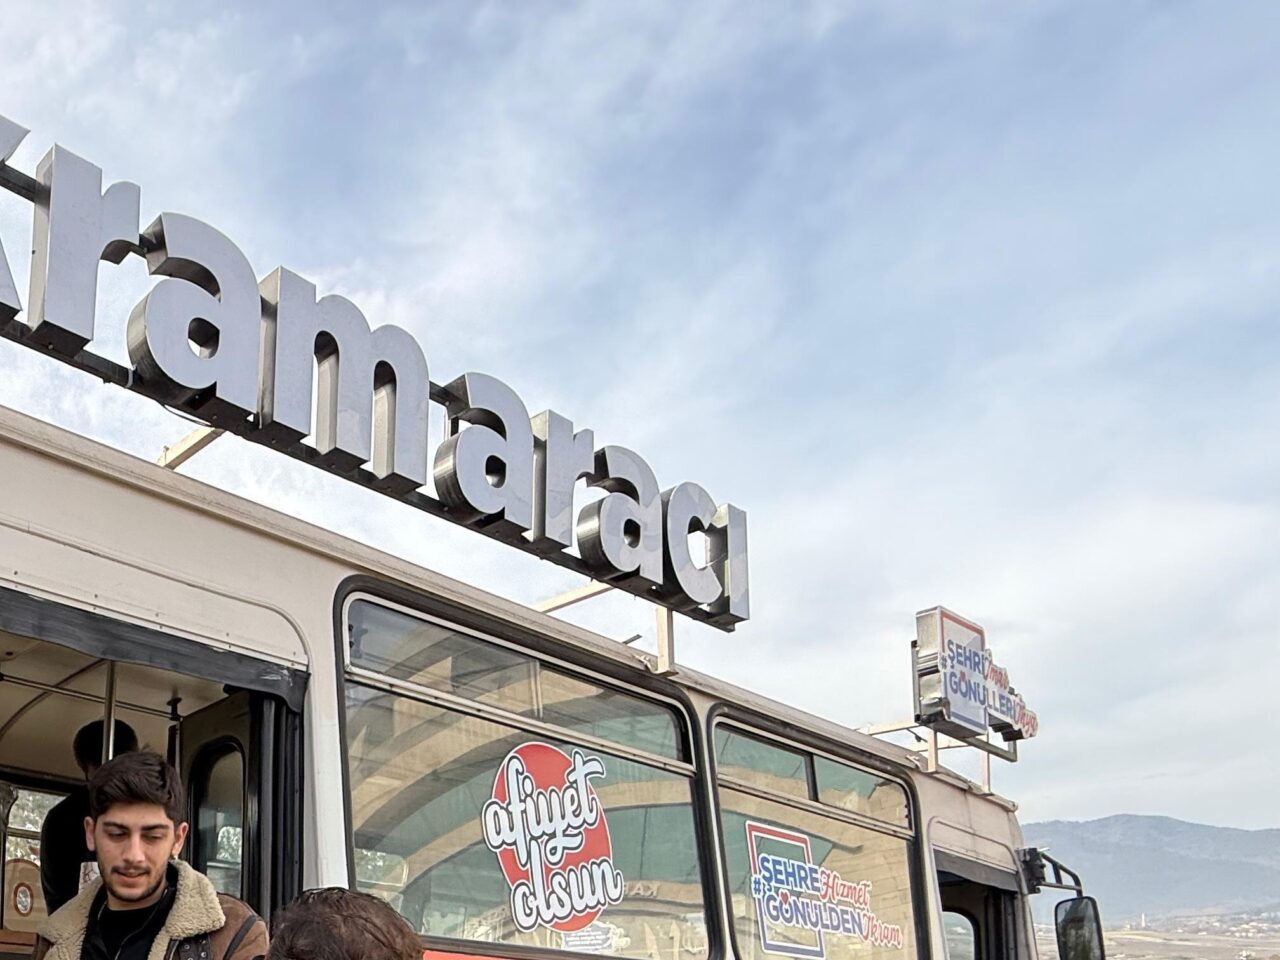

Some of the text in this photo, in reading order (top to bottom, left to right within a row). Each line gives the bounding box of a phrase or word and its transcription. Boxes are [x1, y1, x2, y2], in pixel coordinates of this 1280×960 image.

[483, 750, 605, 867] afiyet
[511, 838, 623, 932] olsun
[760, 855, 821, 893] ŞEHRE
